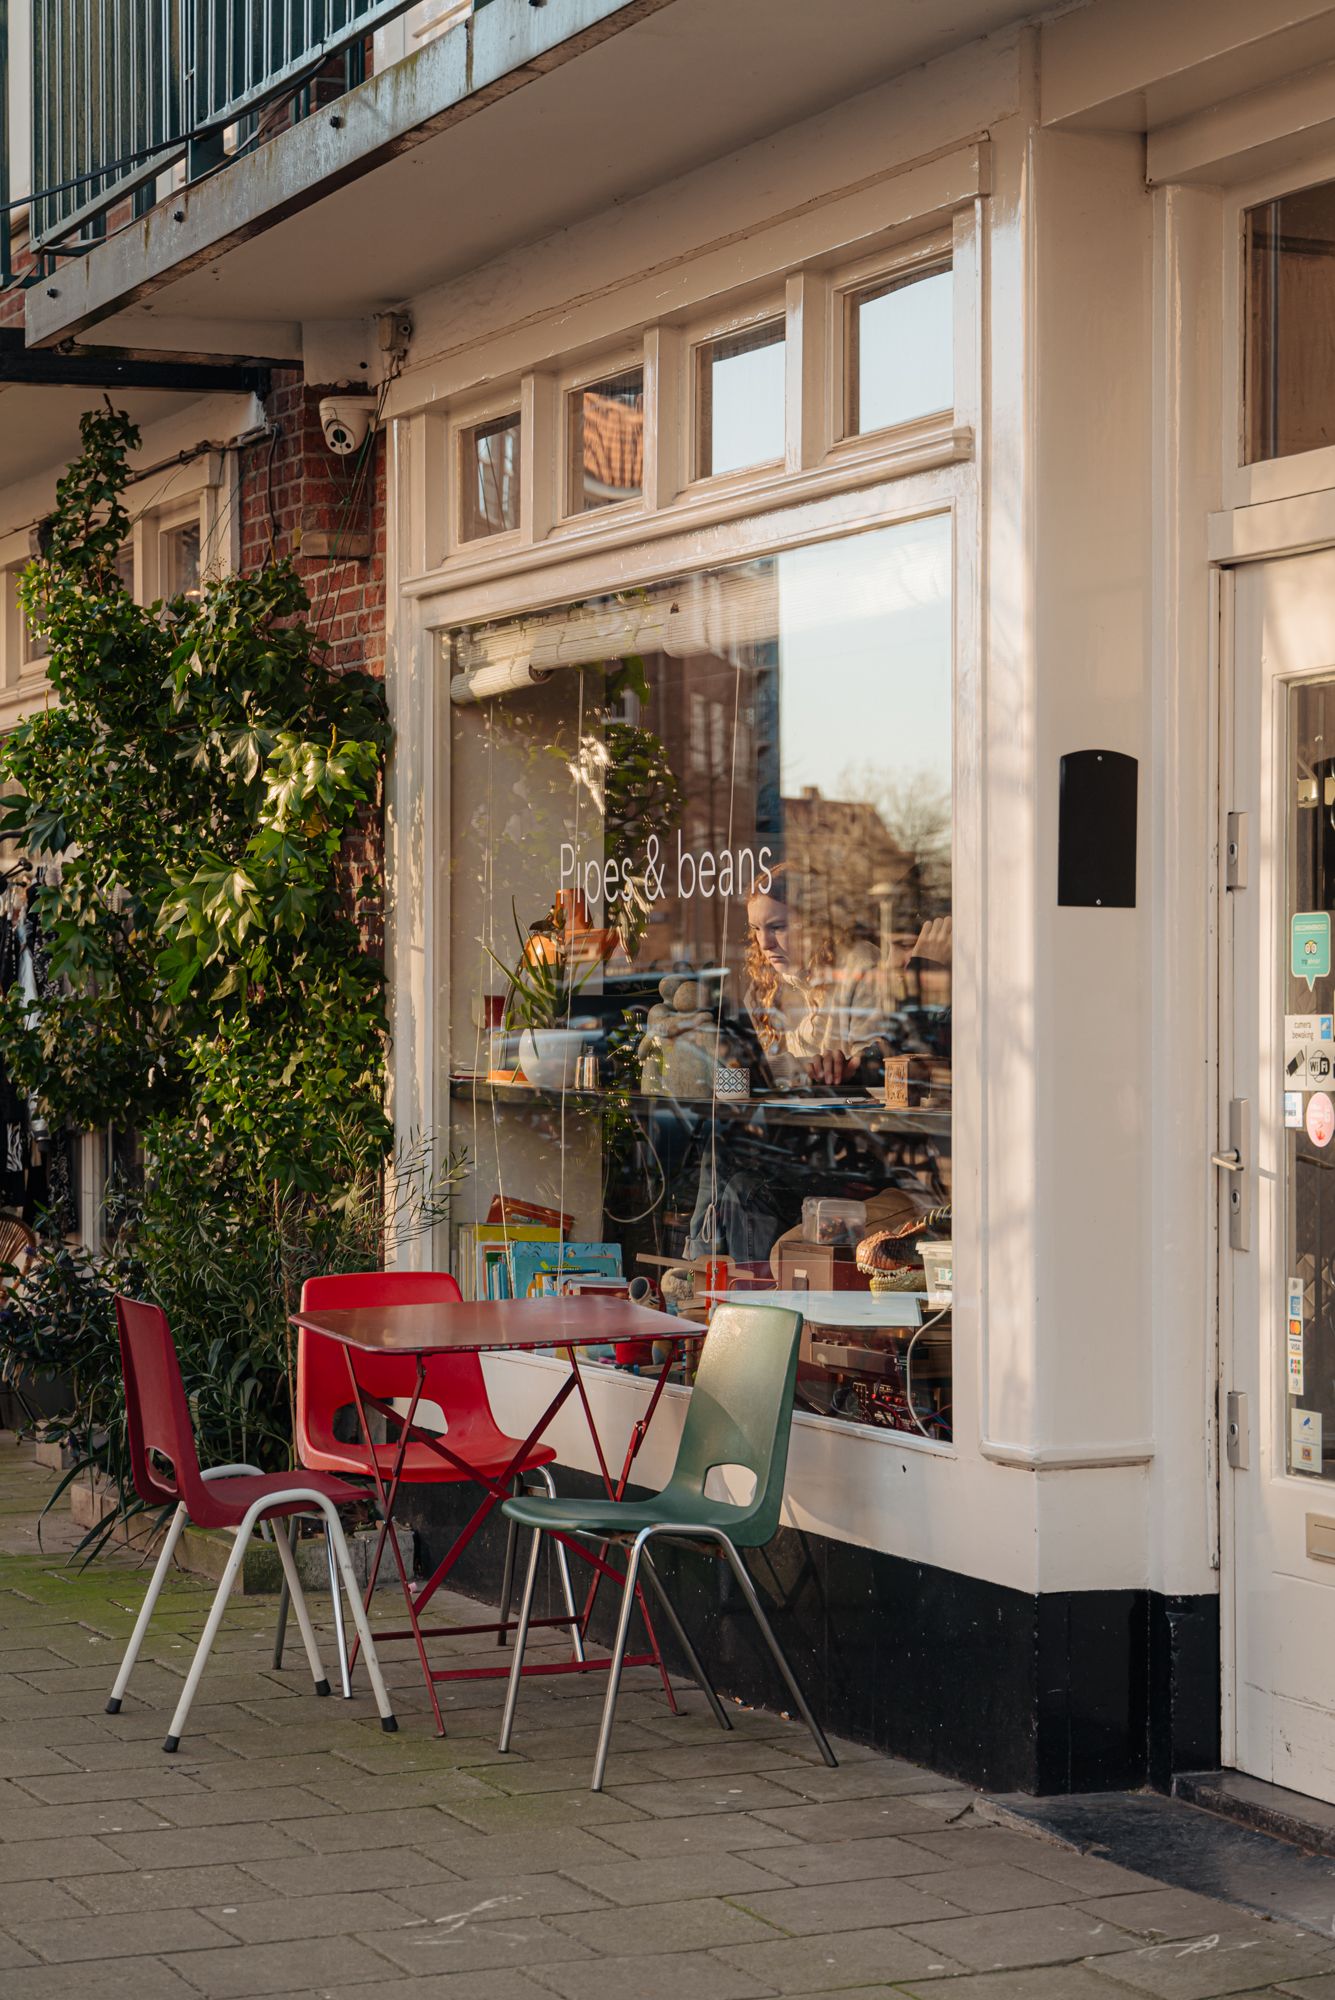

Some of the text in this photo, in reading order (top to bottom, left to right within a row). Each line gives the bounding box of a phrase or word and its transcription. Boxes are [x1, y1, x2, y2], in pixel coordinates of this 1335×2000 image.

[560, 828, 772, 923] Pipes & beans
[1290, 1343, 1301, 1351] VISA
